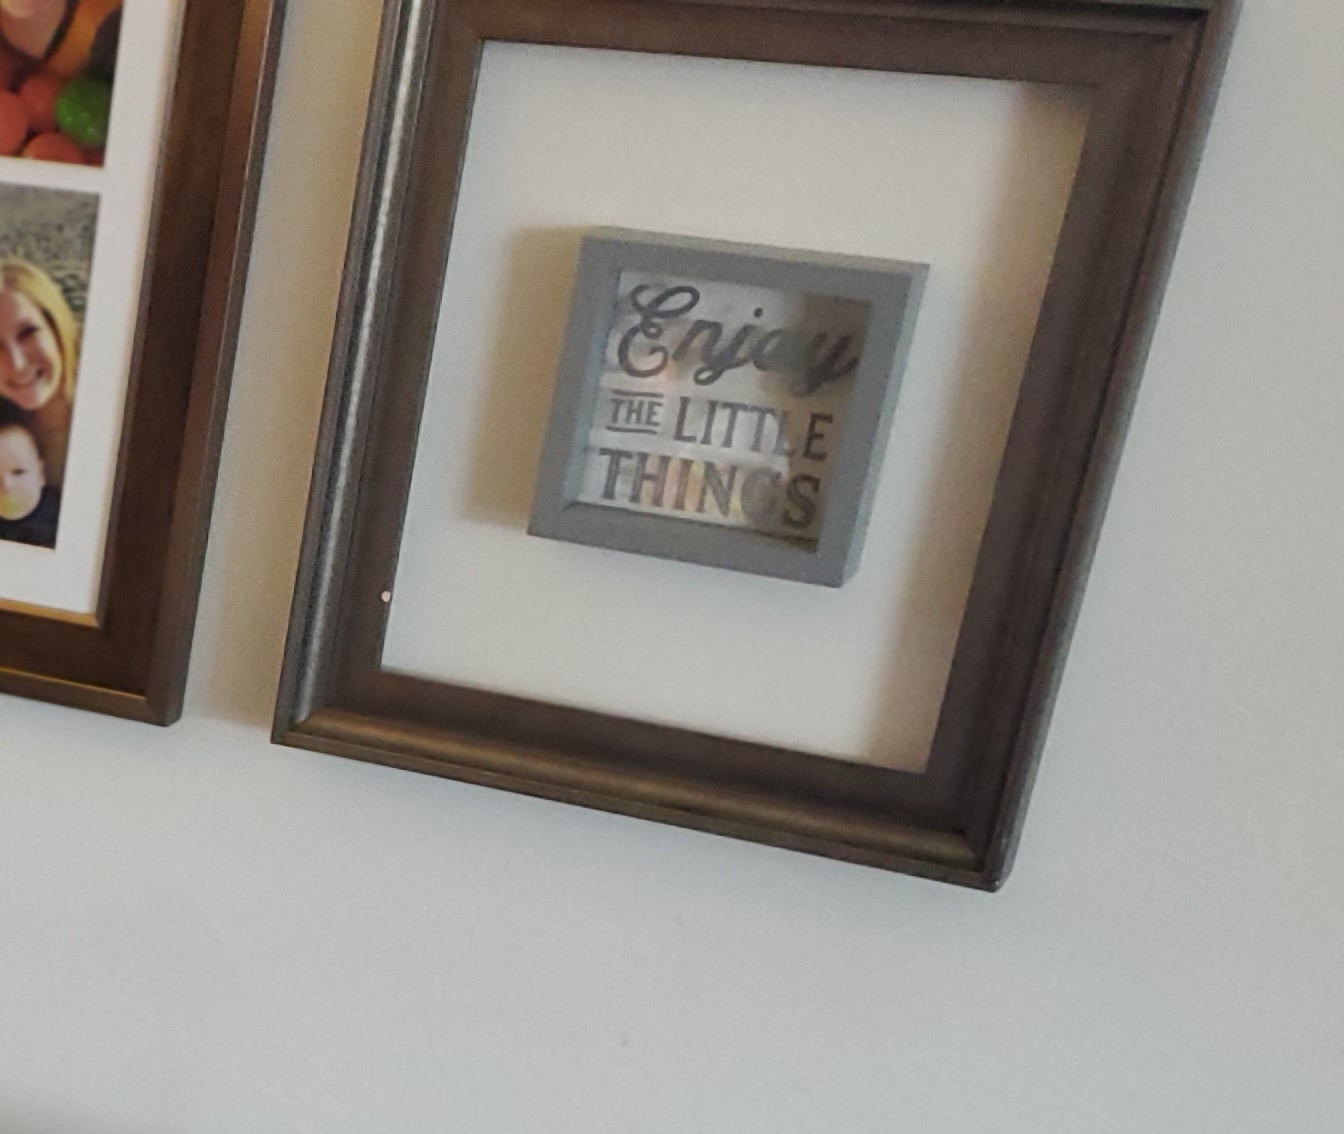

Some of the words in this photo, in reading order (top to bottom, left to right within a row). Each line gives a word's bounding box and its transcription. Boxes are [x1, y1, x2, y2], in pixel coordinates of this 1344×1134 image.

[617, 283, 861, 398] Enjoy
[610, 399, 663, 427] THE
[673, 396, 833, 461] LITTLE
[598, 447, 821, 529] THINGS
